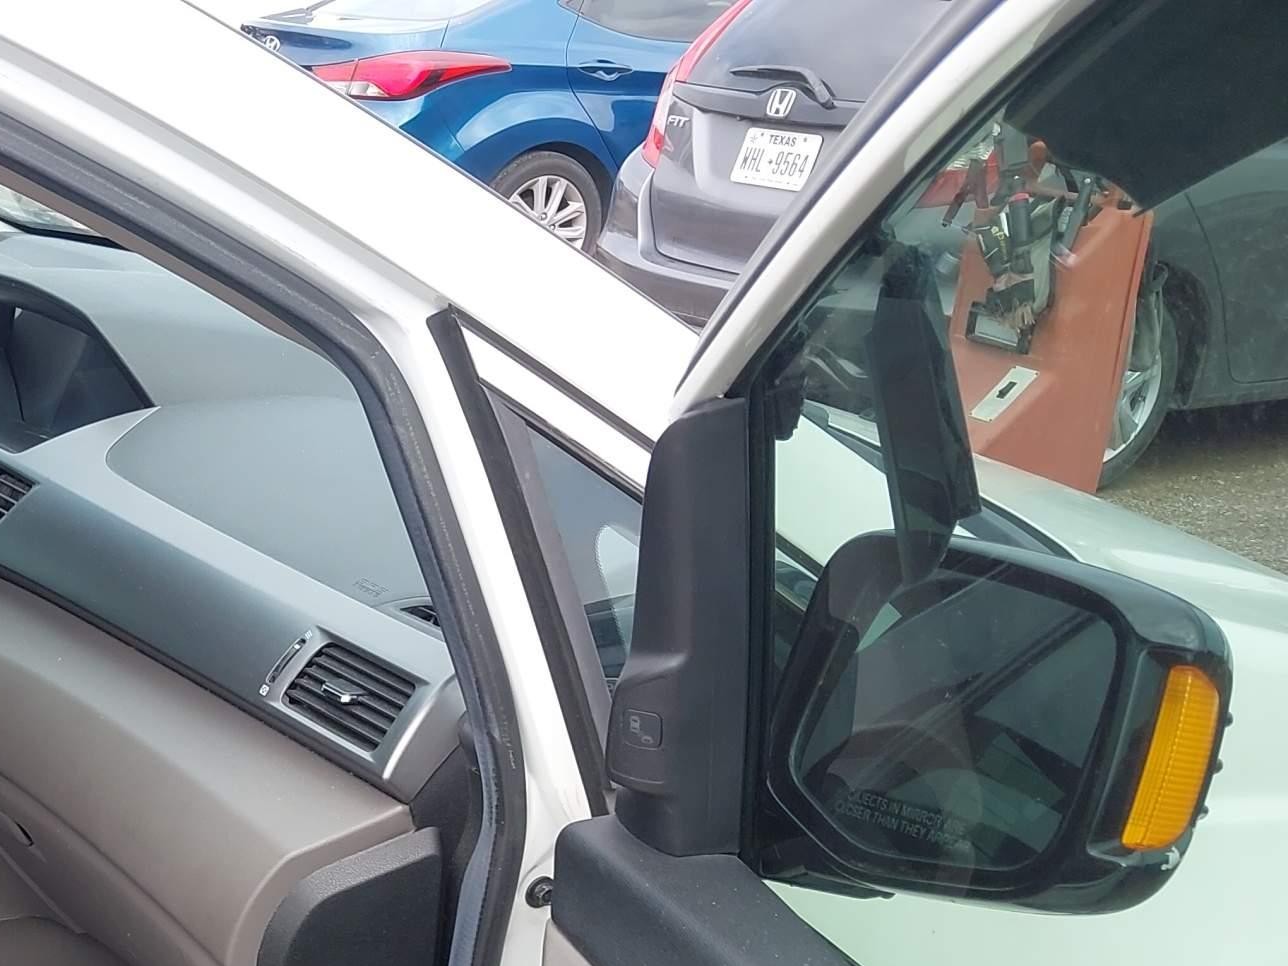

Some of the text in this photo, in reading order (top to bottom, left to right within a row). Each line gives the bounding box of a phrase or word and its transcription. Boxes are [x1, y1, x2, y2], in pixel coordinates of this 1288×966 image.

[667, 114, 690, 128] FIT
[769, 134, 797, 147] TEXAS
[772, 151, 809, 178] 9564
[900, 821, 926, 840] THEY
